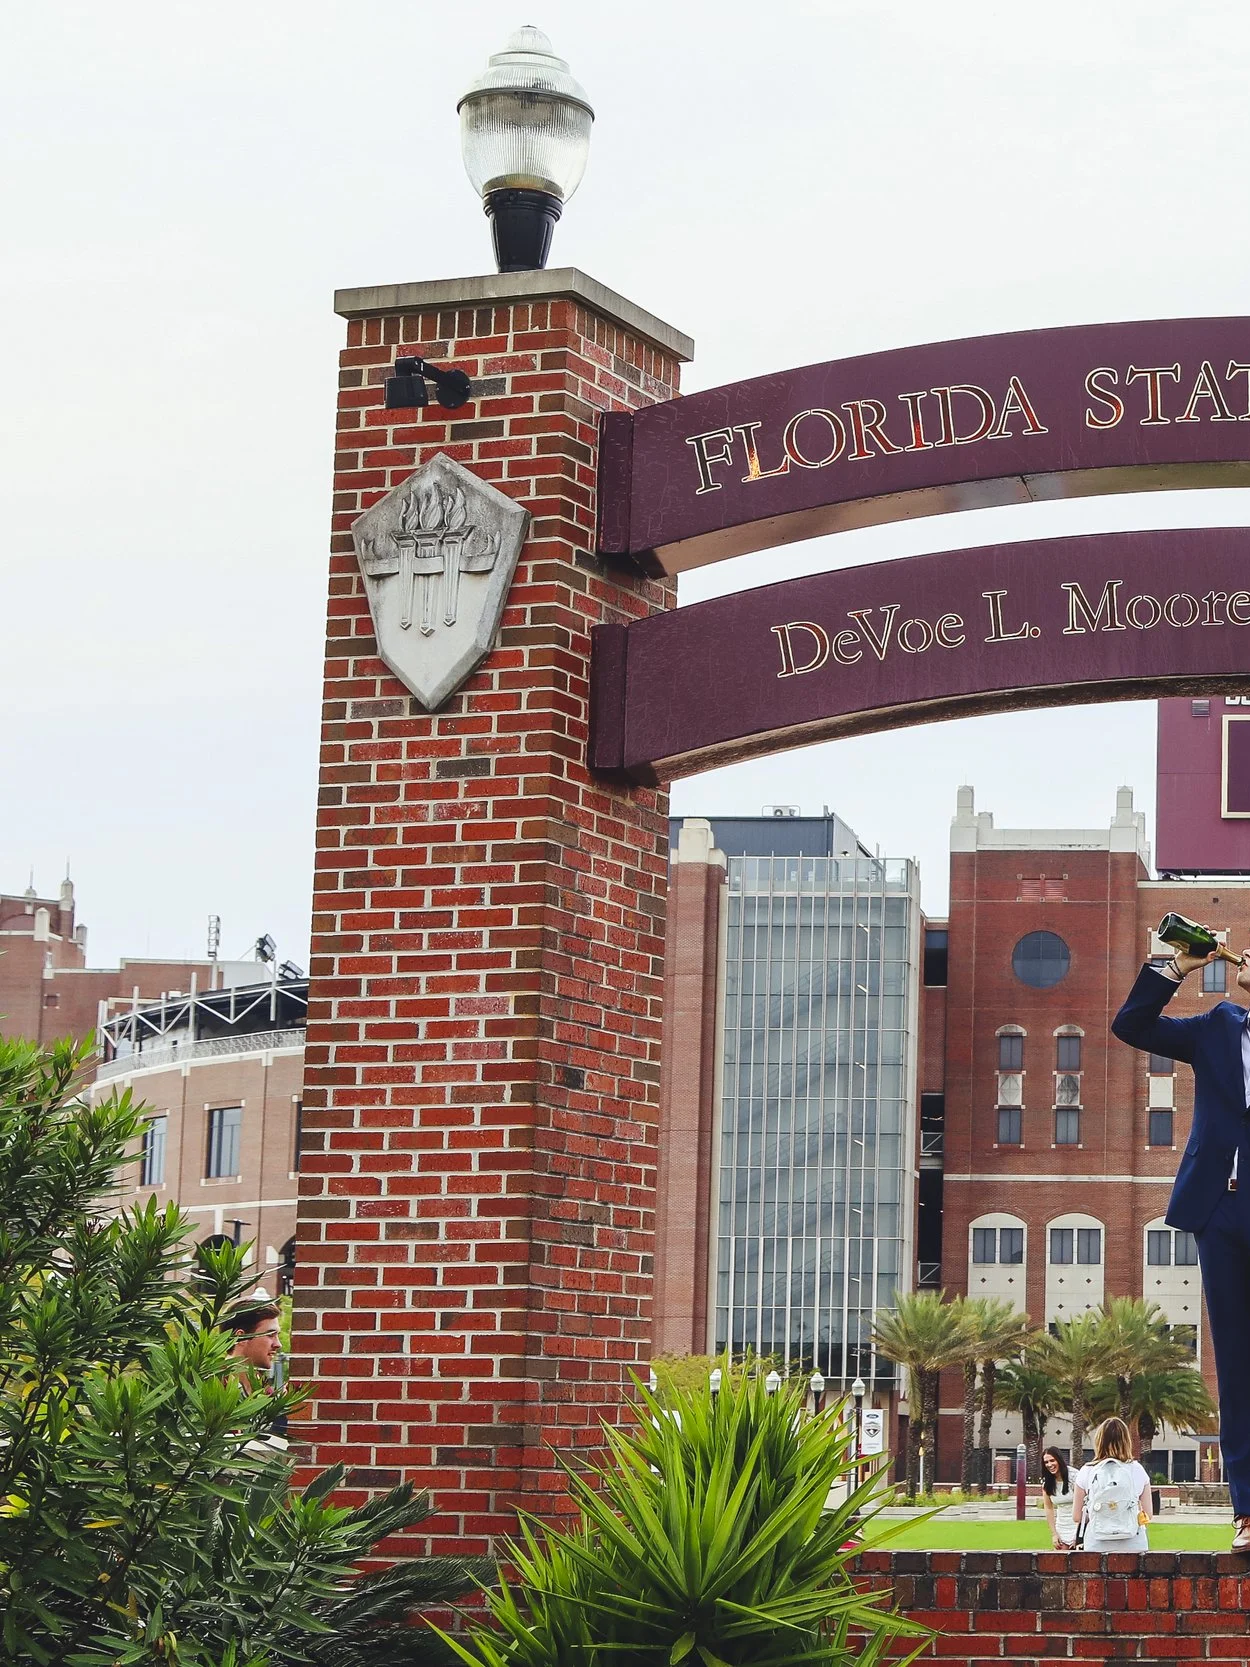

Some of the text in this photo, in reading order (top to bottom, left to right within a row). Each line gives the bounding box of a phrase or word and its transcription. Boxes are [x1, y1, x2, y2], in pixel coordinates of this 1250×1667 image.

[685, 375, 1049, 496] FLORIDA
[770, 603, 966, 679] DeVoe
[982, 590, 1042, 643] L.
